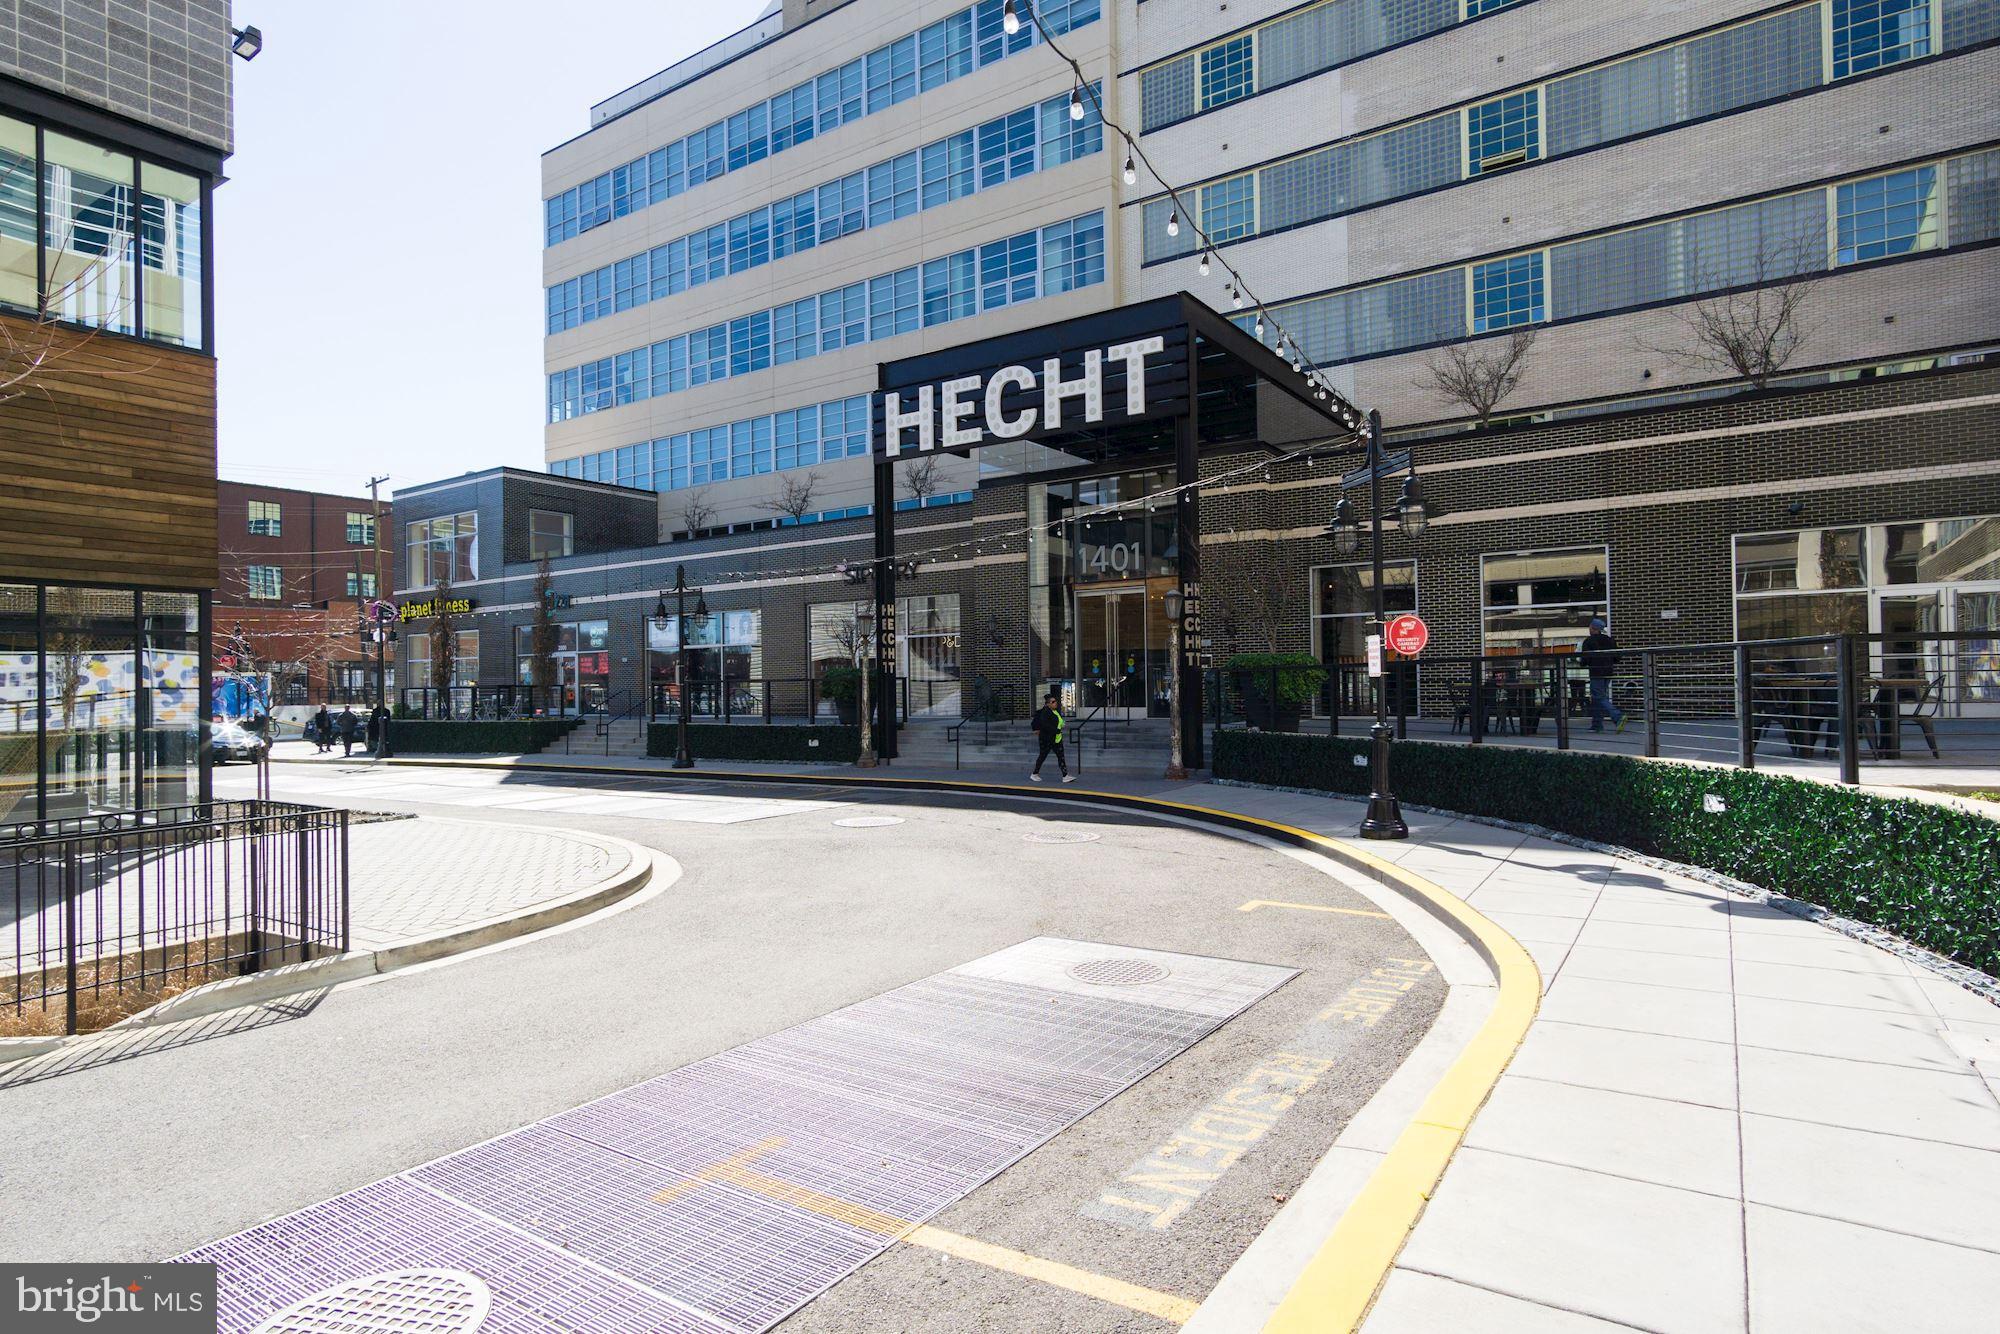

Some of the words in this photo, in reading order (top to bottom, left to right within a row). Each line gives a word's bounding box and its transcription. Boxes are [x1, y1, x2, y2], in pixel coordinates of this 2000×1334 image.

[885, 336, 1164, 457] HECHT
[1078, 542, 1140, 573] 1401
[400, 601, 432, 622] planet
[887, 604, 895, 674] HECHT
[1184, 583, 1194, 666] HECHT
[1102, 1051, 1334, 1230] RESIDENT
